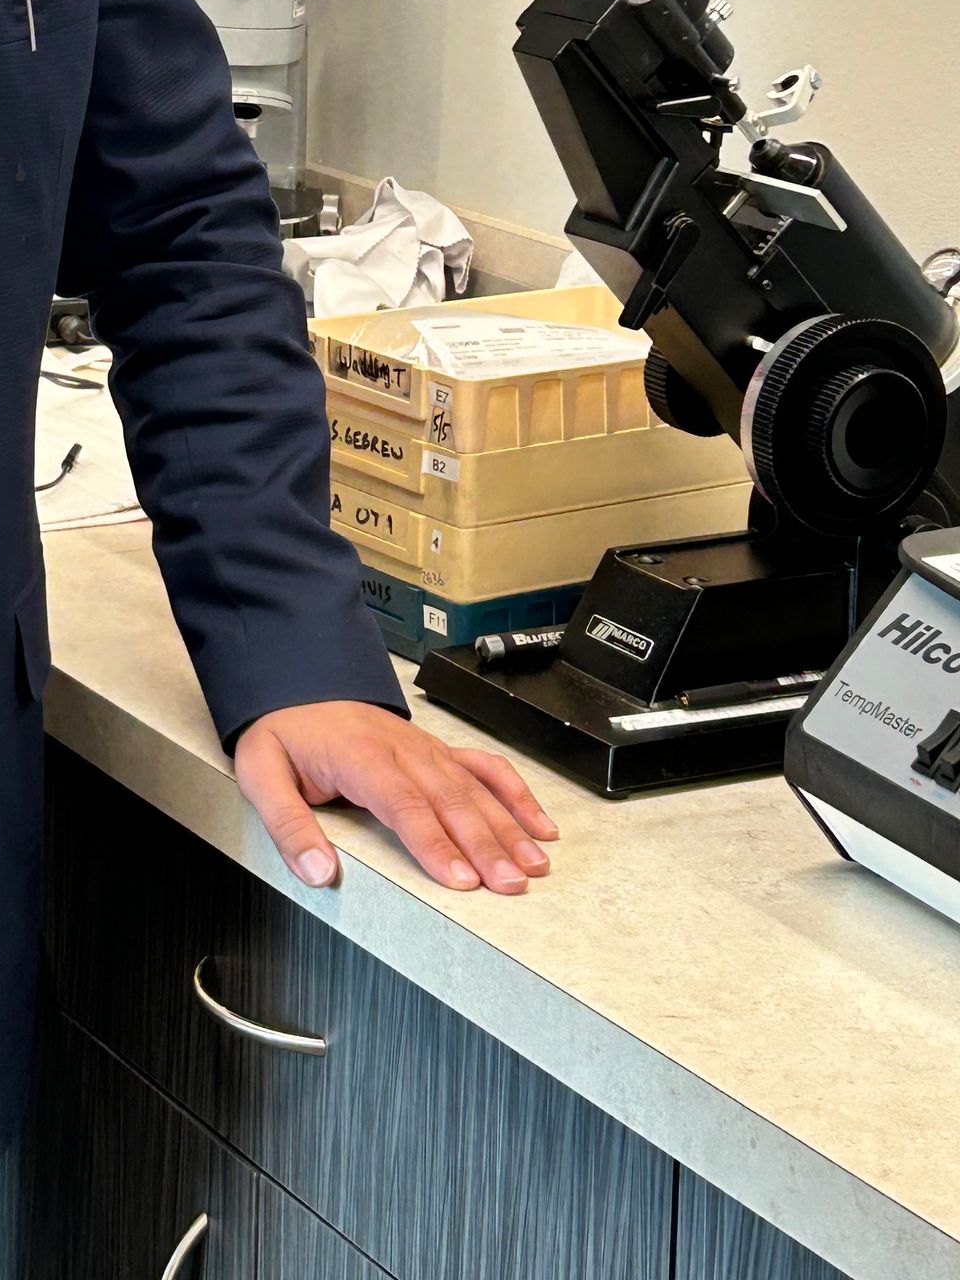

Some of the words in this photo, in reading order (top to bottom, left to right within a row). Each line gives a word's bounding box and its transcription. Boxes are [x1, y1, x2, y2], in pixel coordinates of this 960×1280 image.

[436, 389, 449, 404] E7
[432, 458, 446, 474] B2
[610, 625, 647, 650] MARCO
[834, 680, 923, 739] TempMaster
